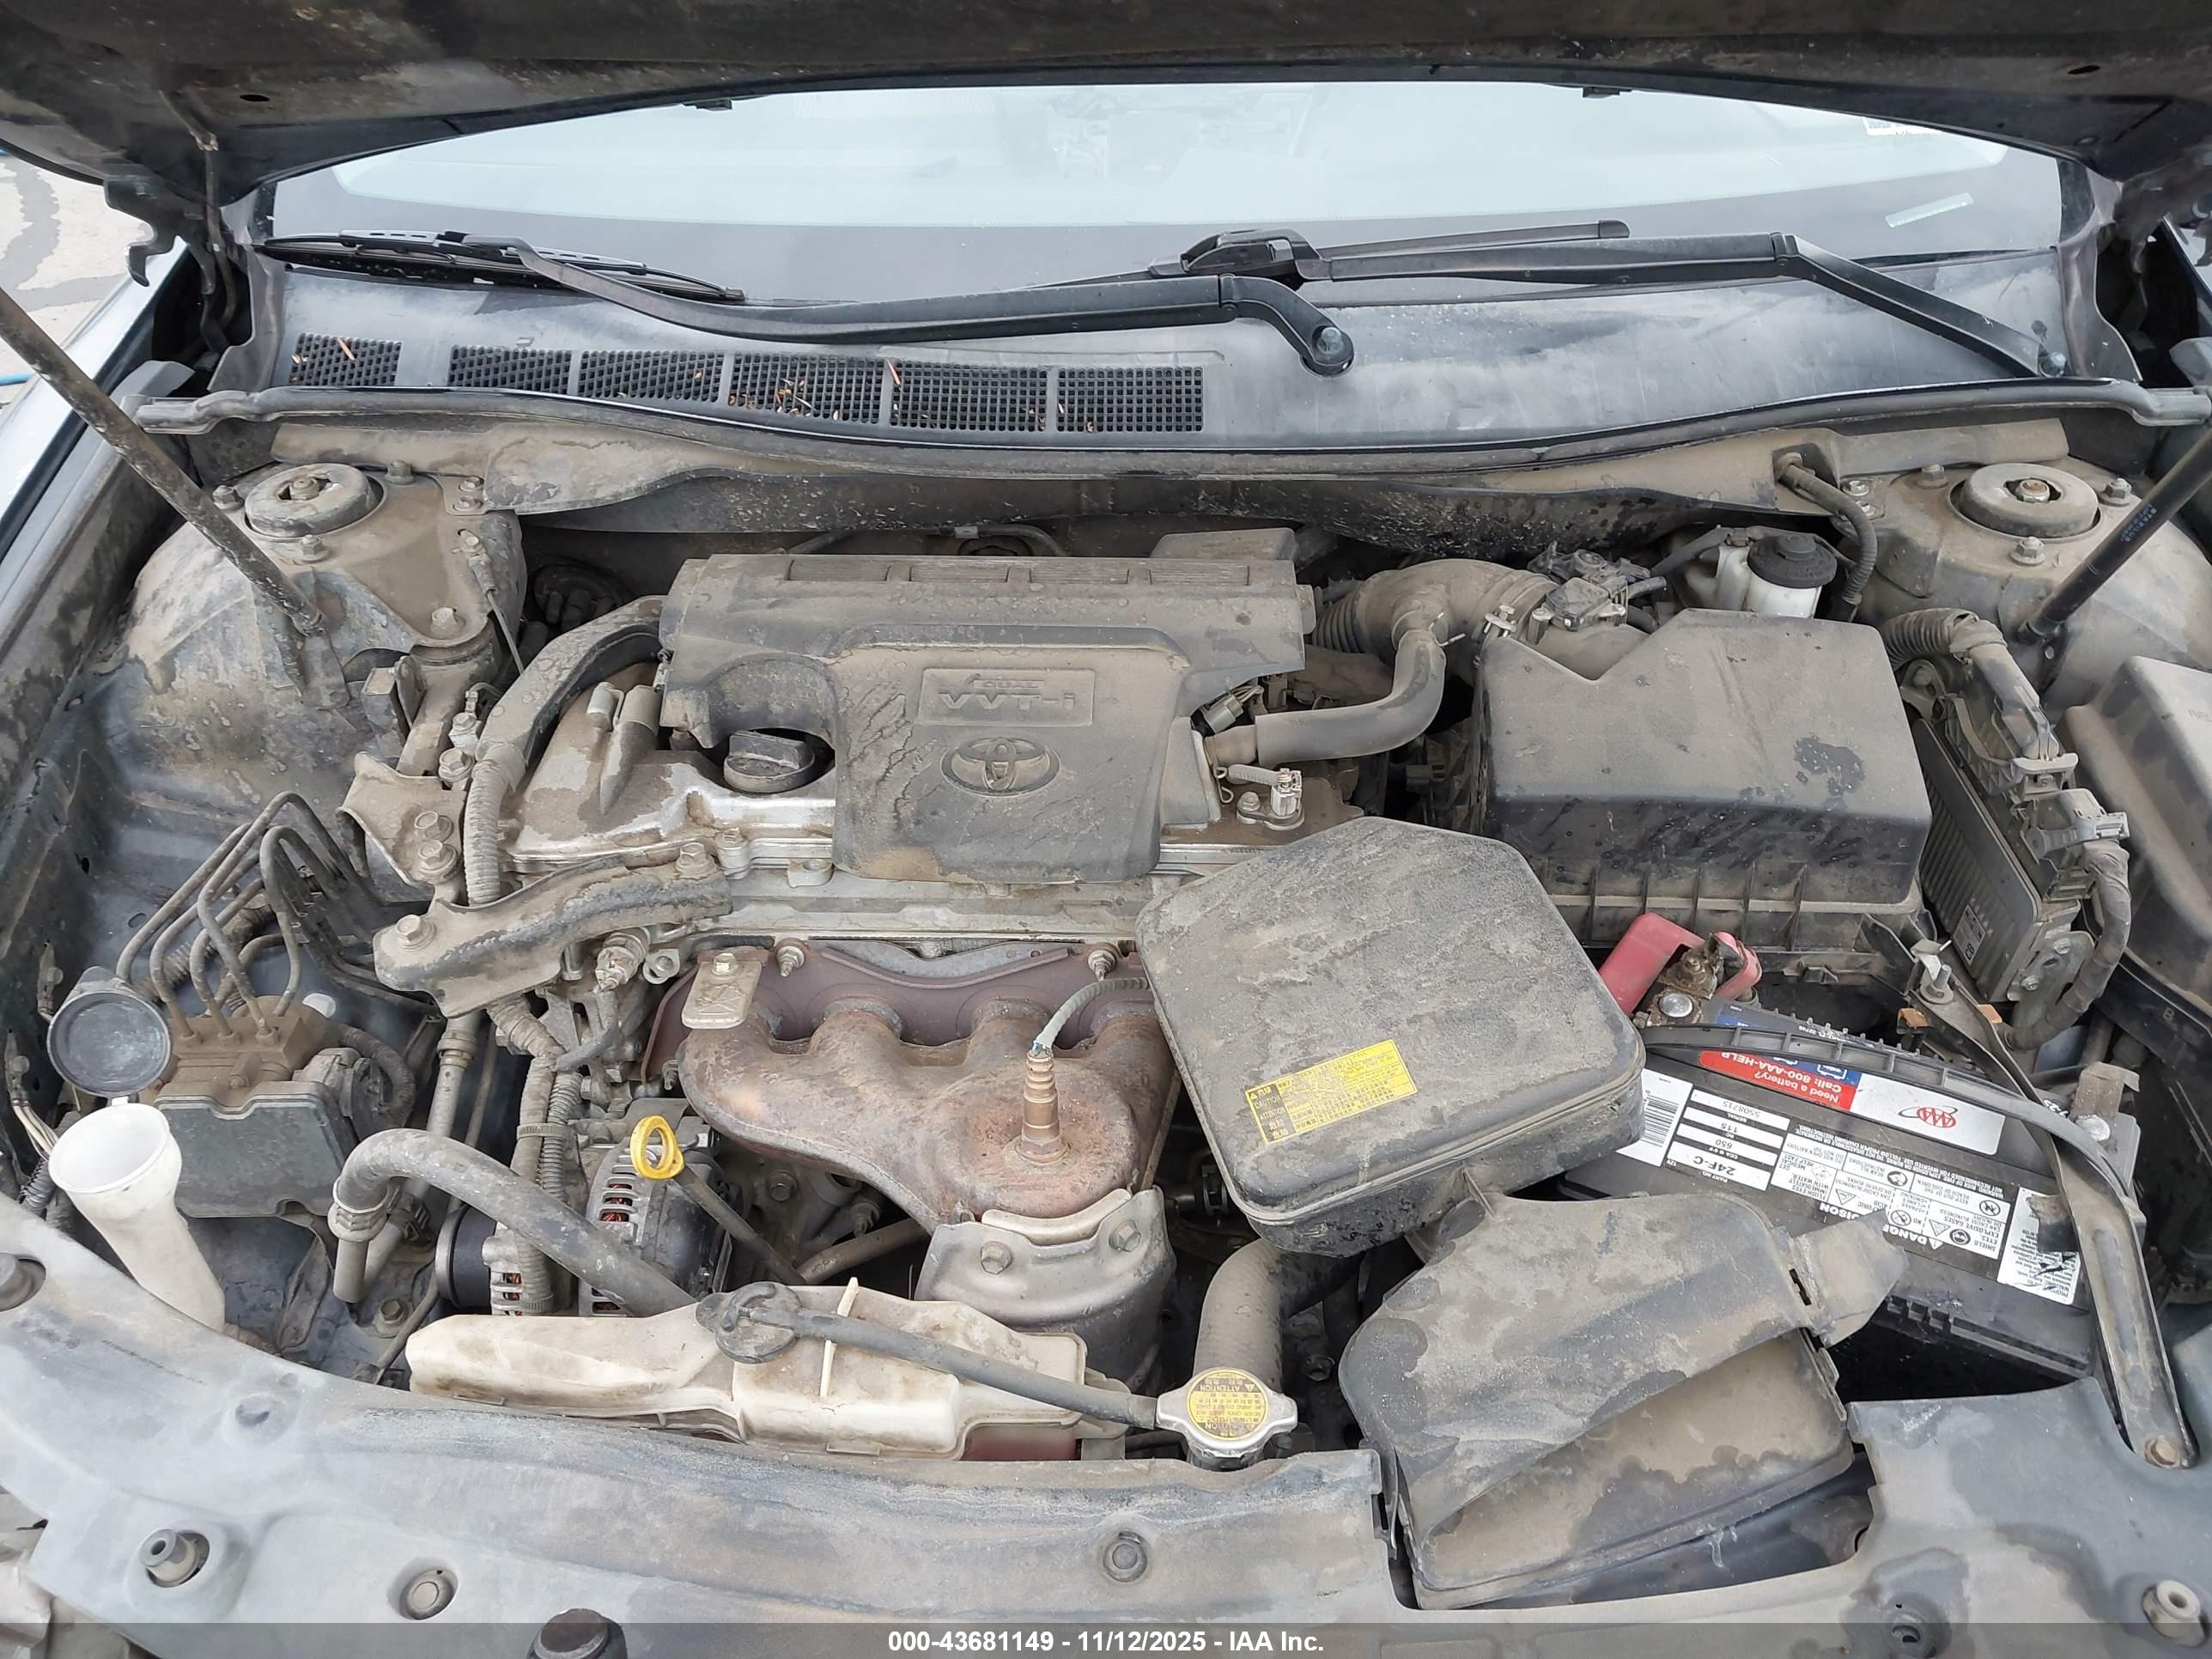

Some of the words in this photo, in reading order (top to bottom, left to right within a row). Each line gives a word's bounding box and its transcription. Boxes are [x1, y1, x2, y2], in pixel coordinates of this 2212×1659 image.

[939, 693, 1074, 709] VVT-i
[1720, 1049, 1811, 1083] 800-AAA-HELP
[1753, 1068, 1798, 1090] battery?
[1813, 1078, 1842, 1093] Call:
[1808, 1087, 1839, 1103] Need
[1720, 1121, 1738, 1133] 115
[1714, 1138, 1733, 1149] 650
[1692, 1154, 1735, 1176] 24F-C
[1711, 1173, 1728, 1182] PART
[1813, 1180, 1829, 1189] WITH
[1790, 1184, 1807, 1193] EYES
[1818, 1201, 1860, 1222] ISON
[1943, 1215, 1964, 1227] GASES
[1971, 1218, 1988, 1228] CAUSE
[1881, 1223, 1928, 1244] DANGE
[1964, 1222, 1999, 1238] EXPLOSIVE
[1973, 1239, 1996, 1251] SHIELD
